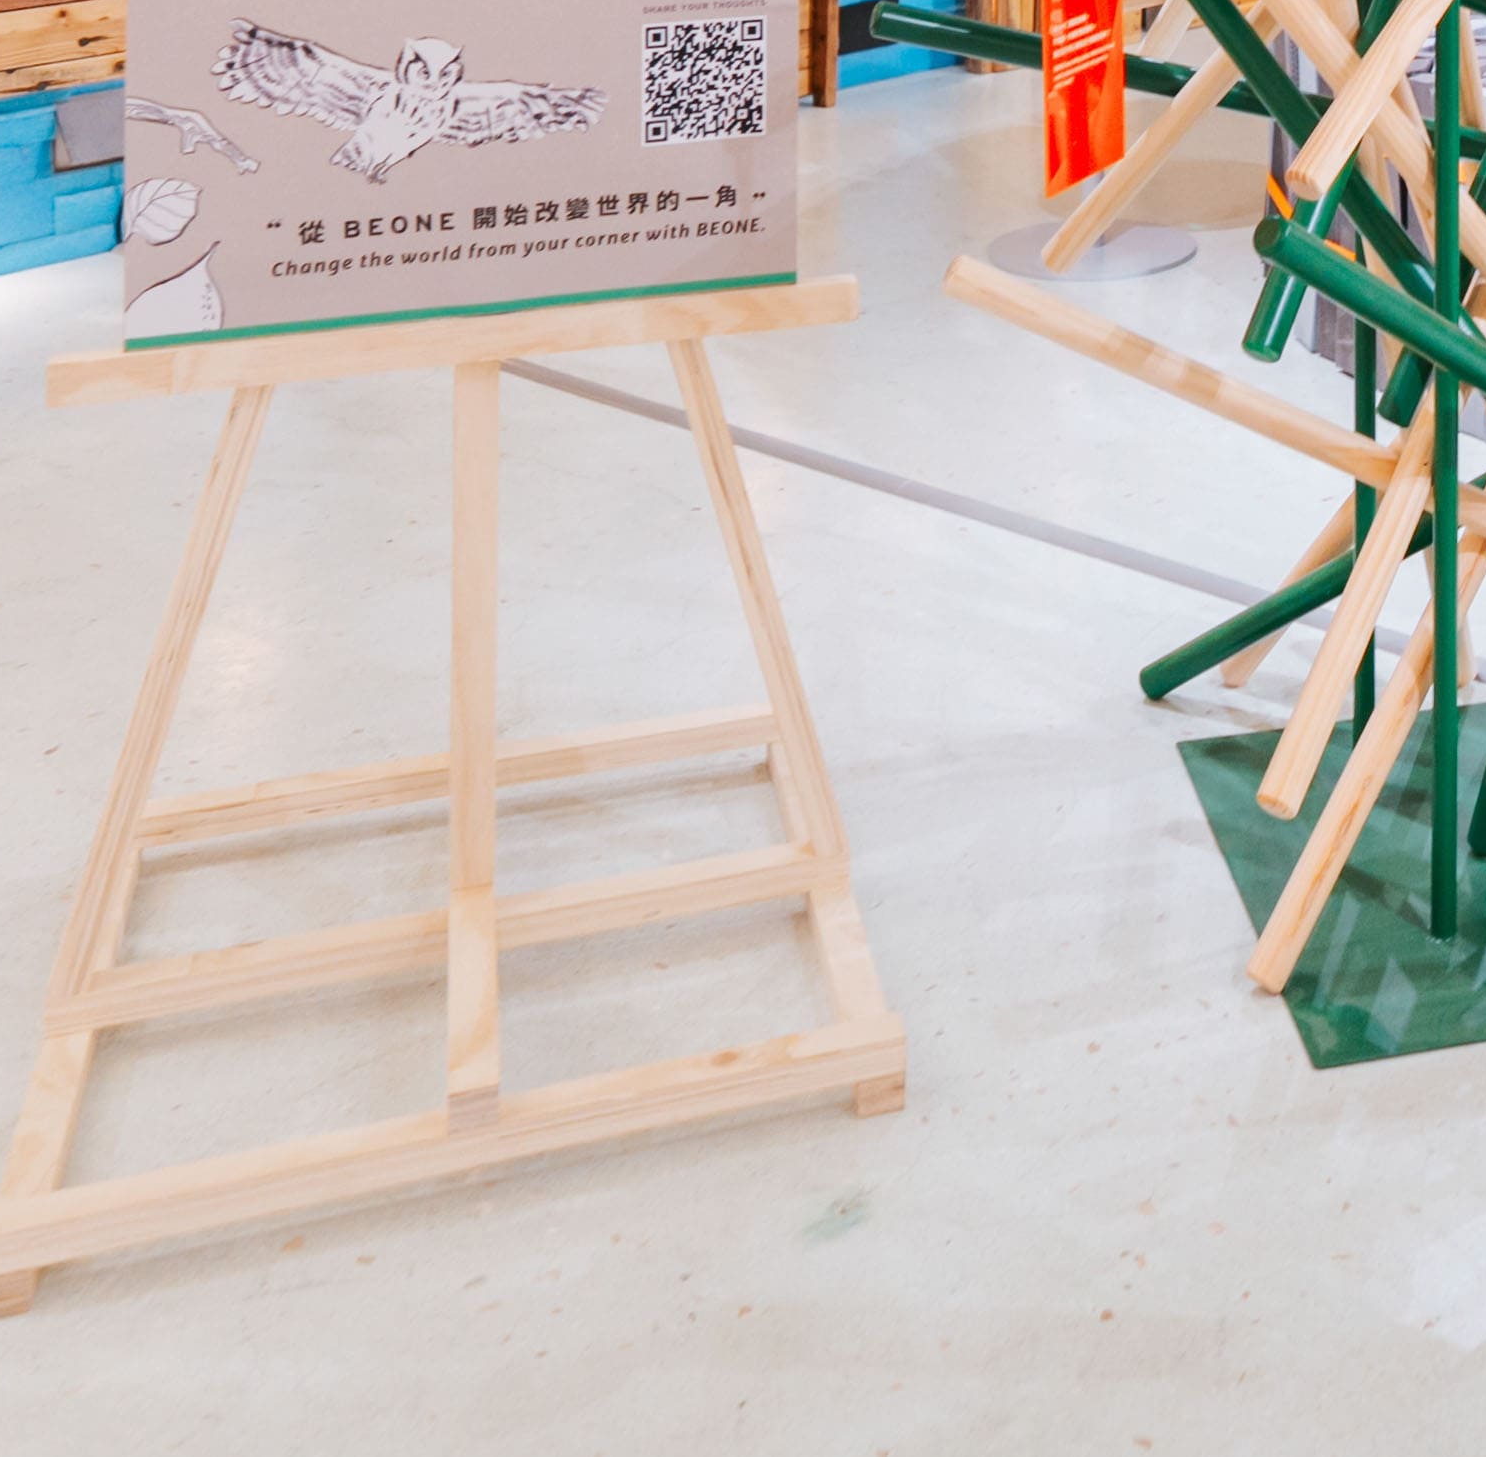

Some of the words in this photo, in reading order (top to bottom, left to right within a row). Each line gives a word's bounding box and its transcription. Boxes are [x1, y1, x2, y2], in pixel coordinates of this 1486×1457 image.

[343, 211, 456, 240] BEONE
[472, 185, 739, 231] 開始改變世界的一角
[271, 255, 352, 281] Change
[359, 249, 394, 268] the
[400, 244, 461, 265] world
[468, 239, 516, 258] from
[523, 237, 569, 257] your
[574, 231, 639, 248] corner
[645, 222, 689, 241] with
[696, 216, 765, 237] BEONE.
